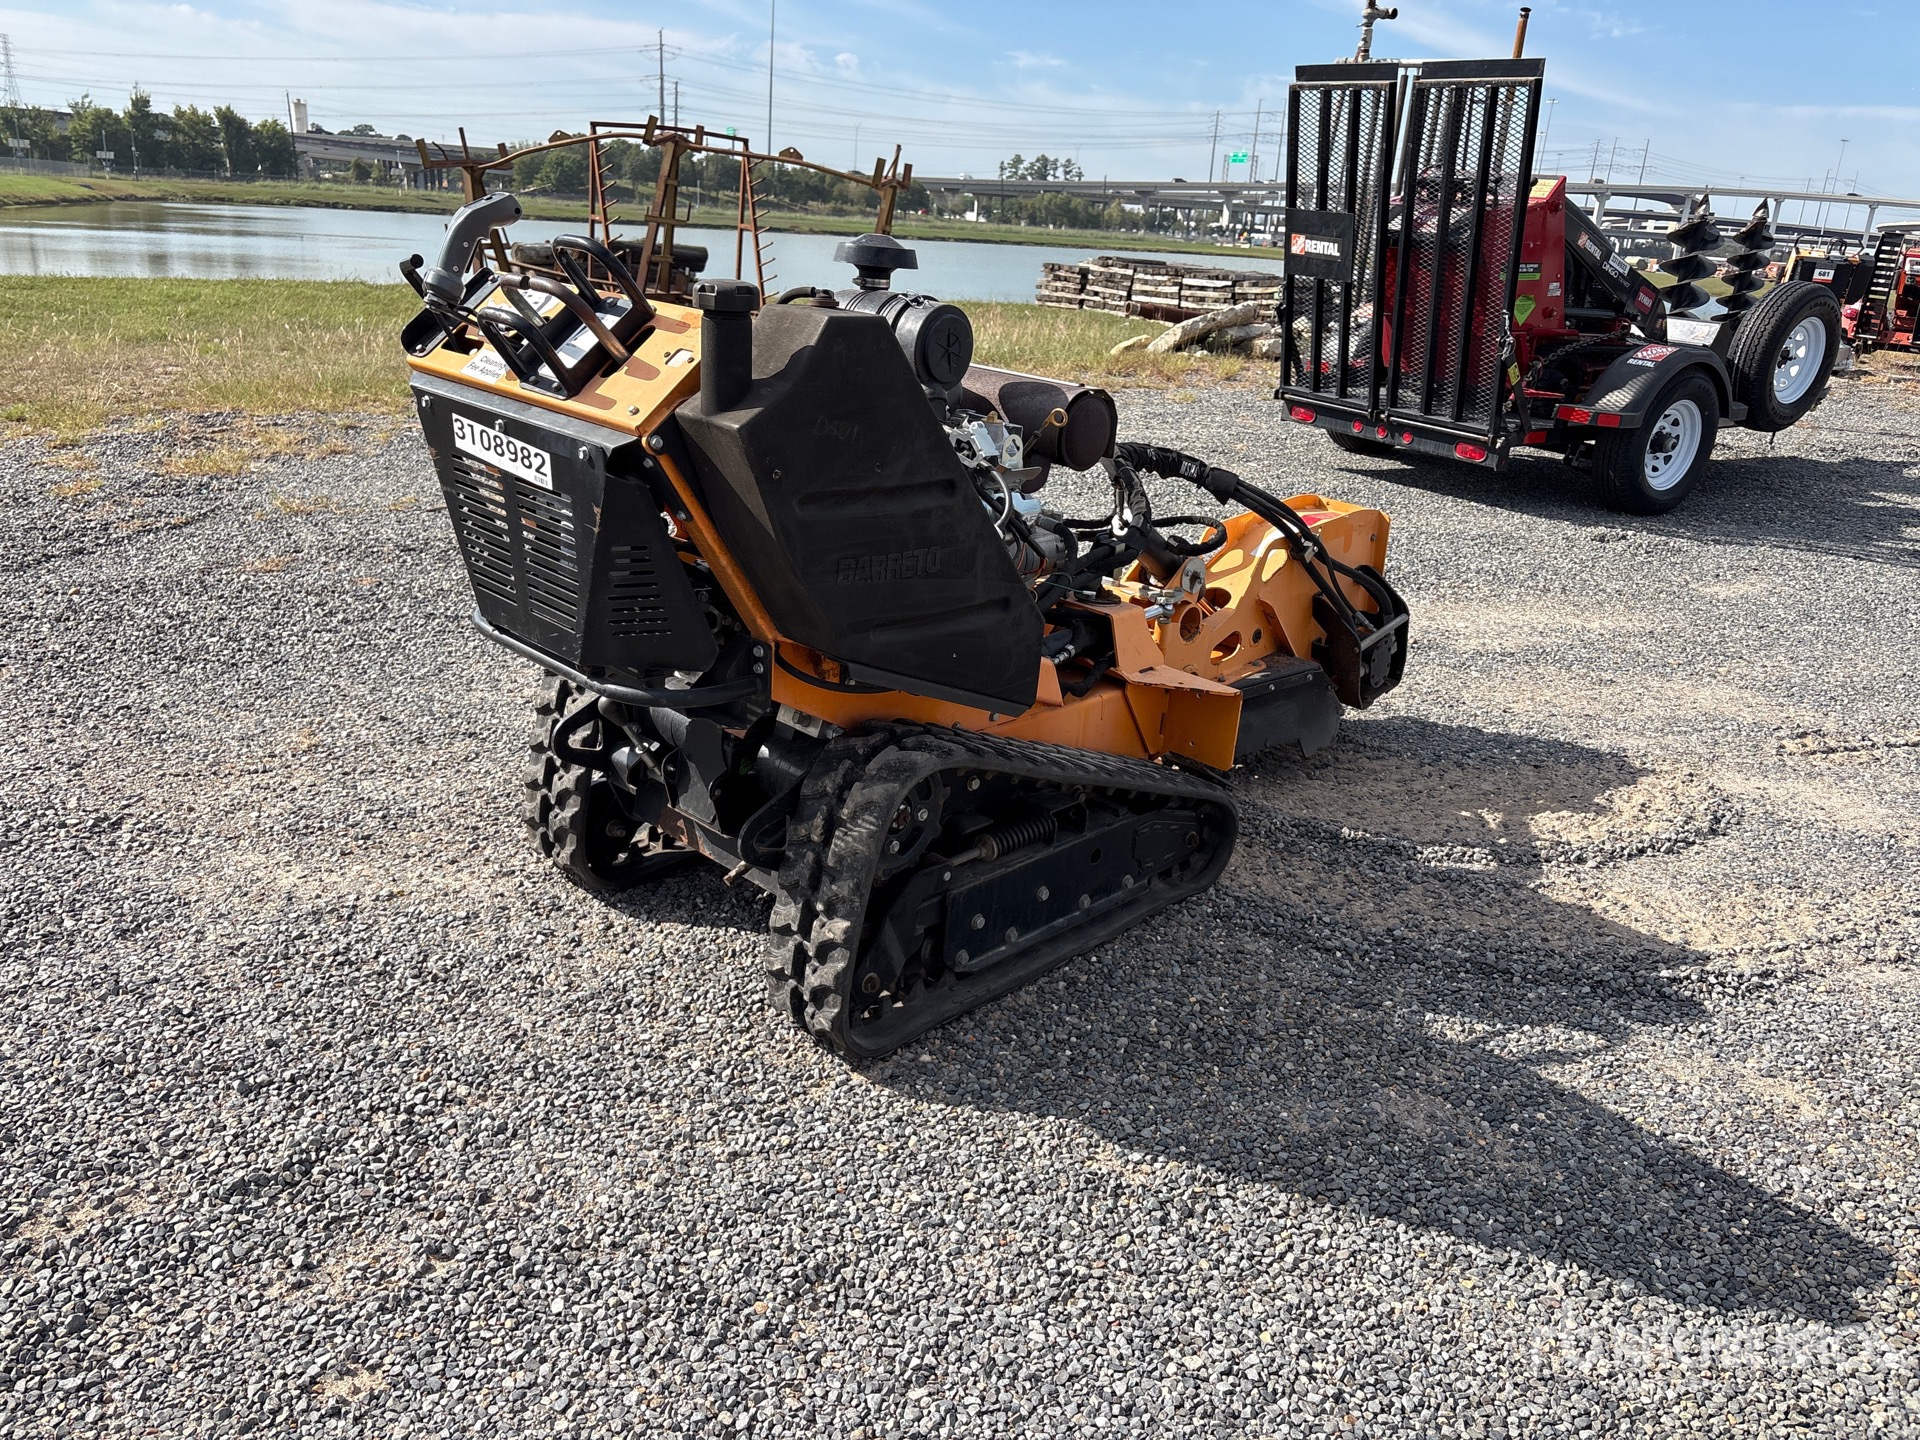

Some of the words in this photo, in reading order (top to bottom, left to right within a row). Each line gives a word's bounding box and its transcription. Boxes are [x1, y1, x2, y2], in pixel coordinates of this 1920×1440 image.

[1305, 239, 1340, 257] RENTAL
[1585, 239, 1602, 260] RENTAL
[1602, 261, 1619, 278] DINGO
[1638, 292, 1653, 307] TORO
[467, 362, 480, 372] Fee
[478, 366, 501, 379] Applies
[480, 355, 506, 370] Cleaning
[1626, 359, 1655, 367] RENTAL
[453, 417, 548, 478] 3108982
[836, 547, 941, 585] BARRETO
